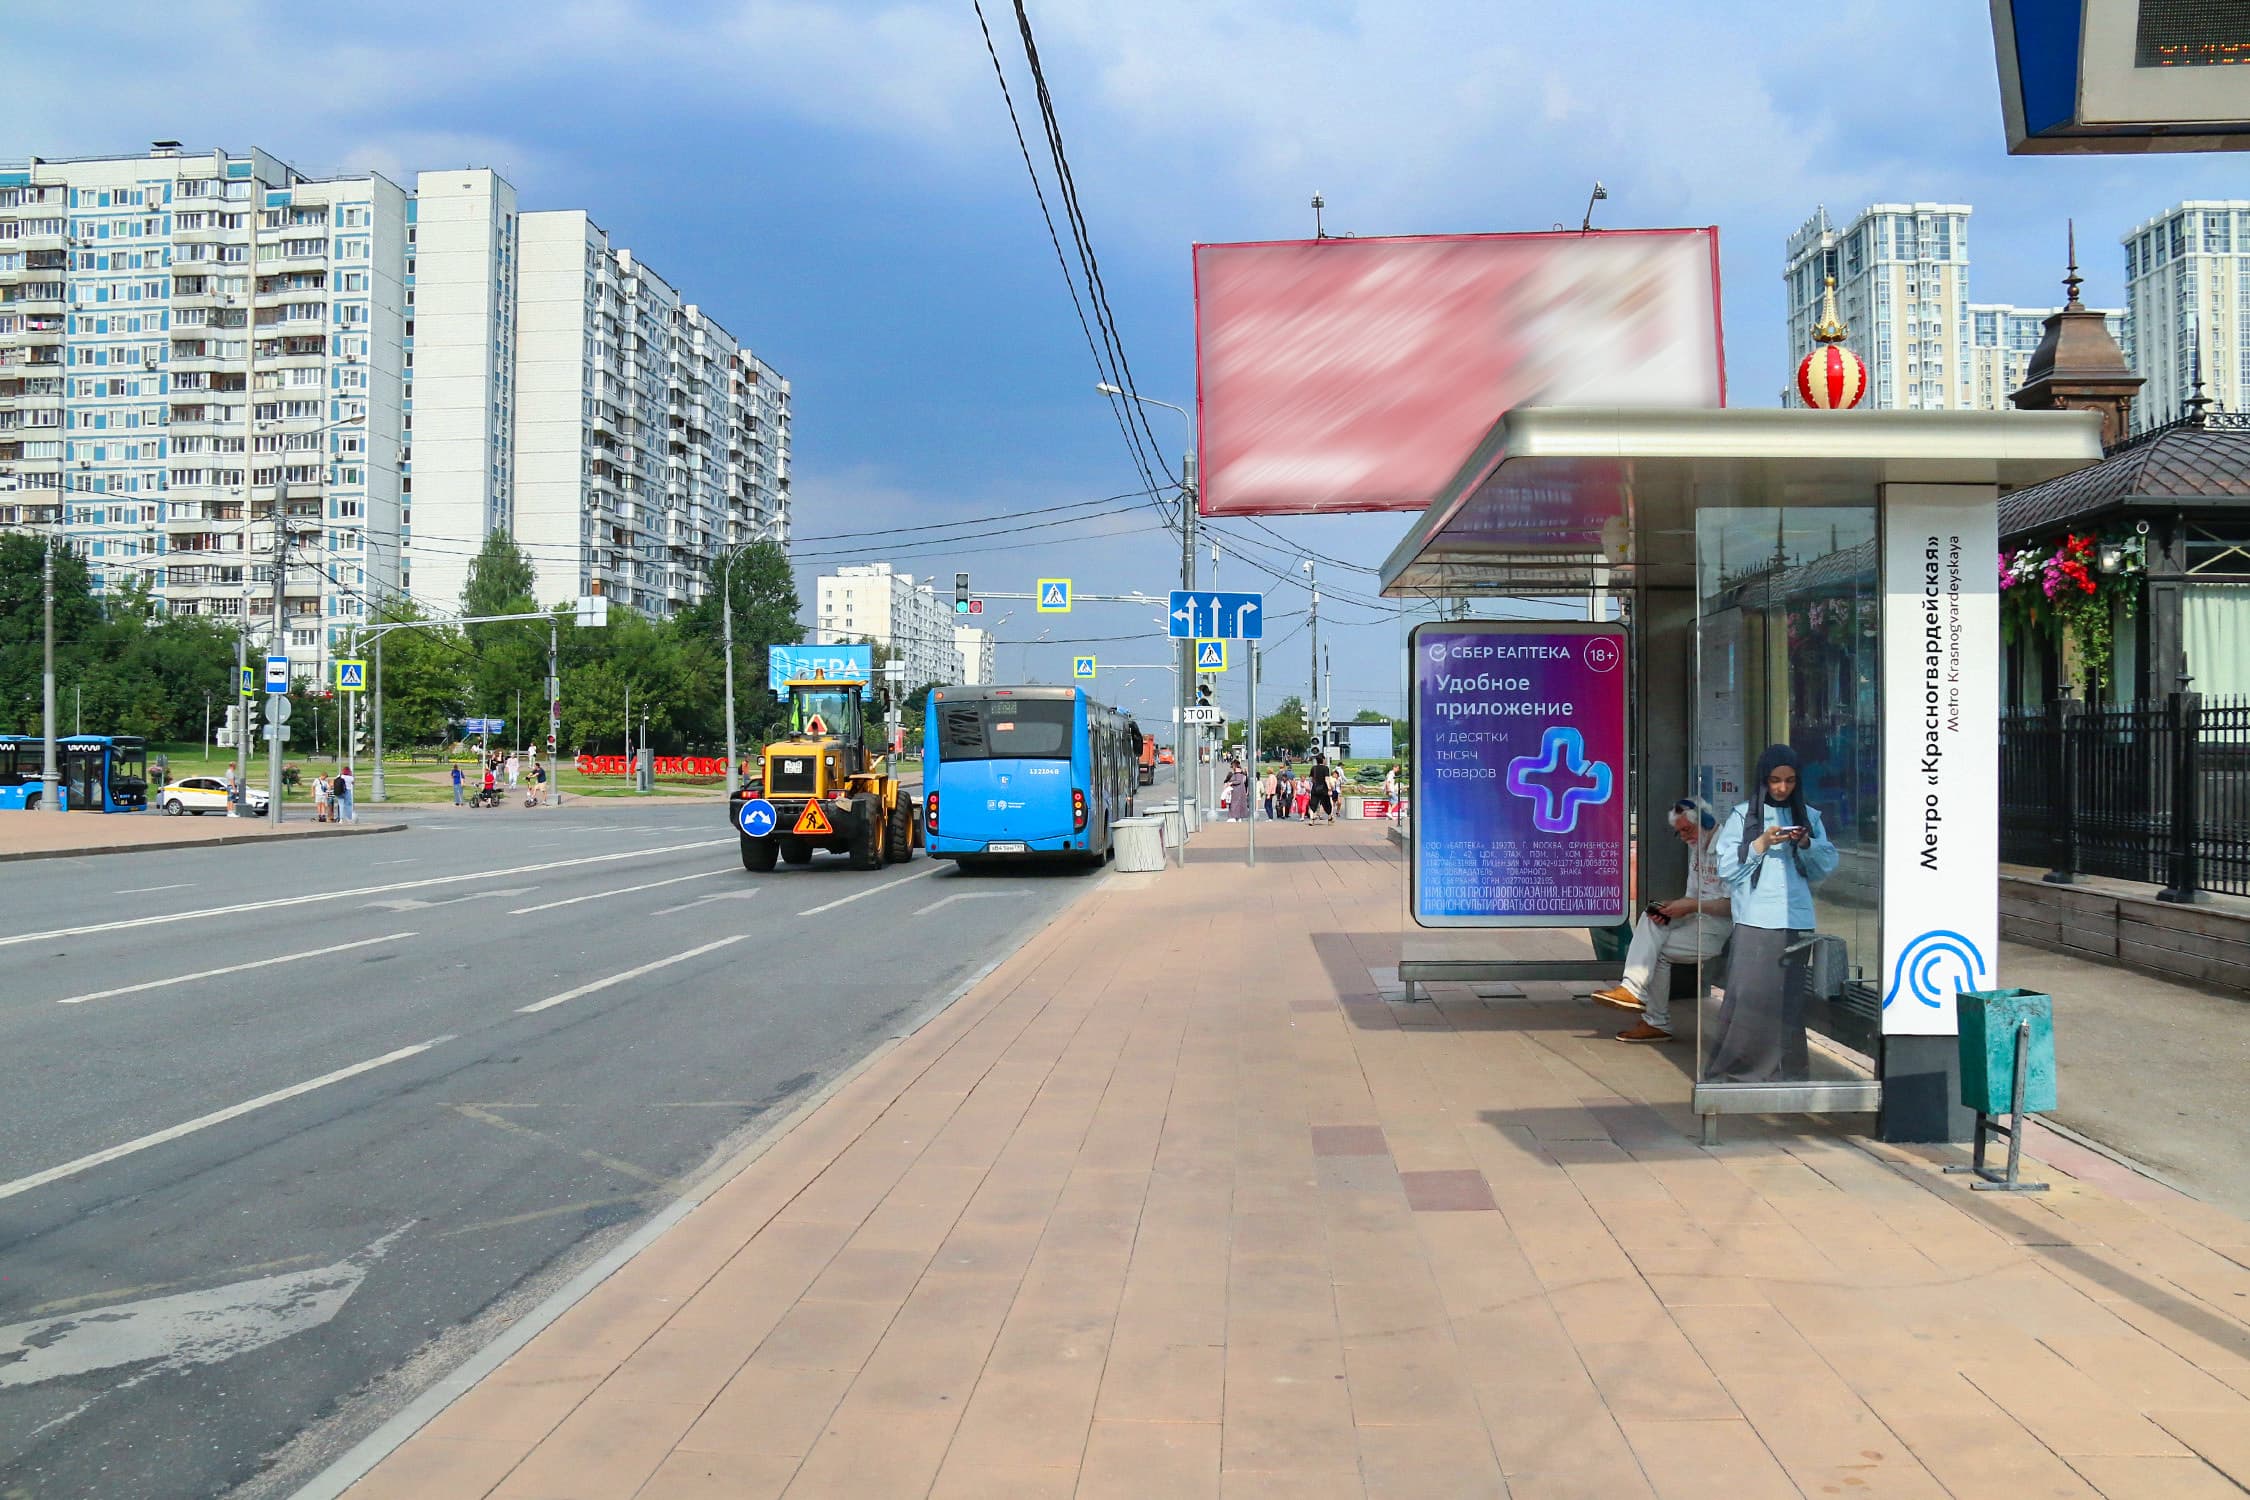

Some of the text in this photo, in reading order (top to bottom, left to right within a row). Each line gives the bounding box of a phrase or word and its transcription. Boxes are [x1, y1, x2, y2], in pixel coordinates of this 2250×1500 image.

[1946, 535, 1963, 733] Metro Krasnogvardeyskaya
[1451, 646, 1571, 659] СБЕР ЕАПТЕКА
[1589, 649, 1615, 662] 18+
[1435, 672, 1530, 694] Удобное
[1920, 536, 1942, 871] Метро «Красногвардейская»
[1436, 702, 1574, 719] приложение
[1436, 731, 1508, 745] и десятки
[1436, 750, 1478, 760] тысяч
[1435, 768, 1497, 781] товаров
[1561, 886, 1620, 898] НЕОБХОДИМО
[1536, 899, 1548, 911] СО
[1549, 899, 1620, 911] СПЕЦИАЛИСТОМ
